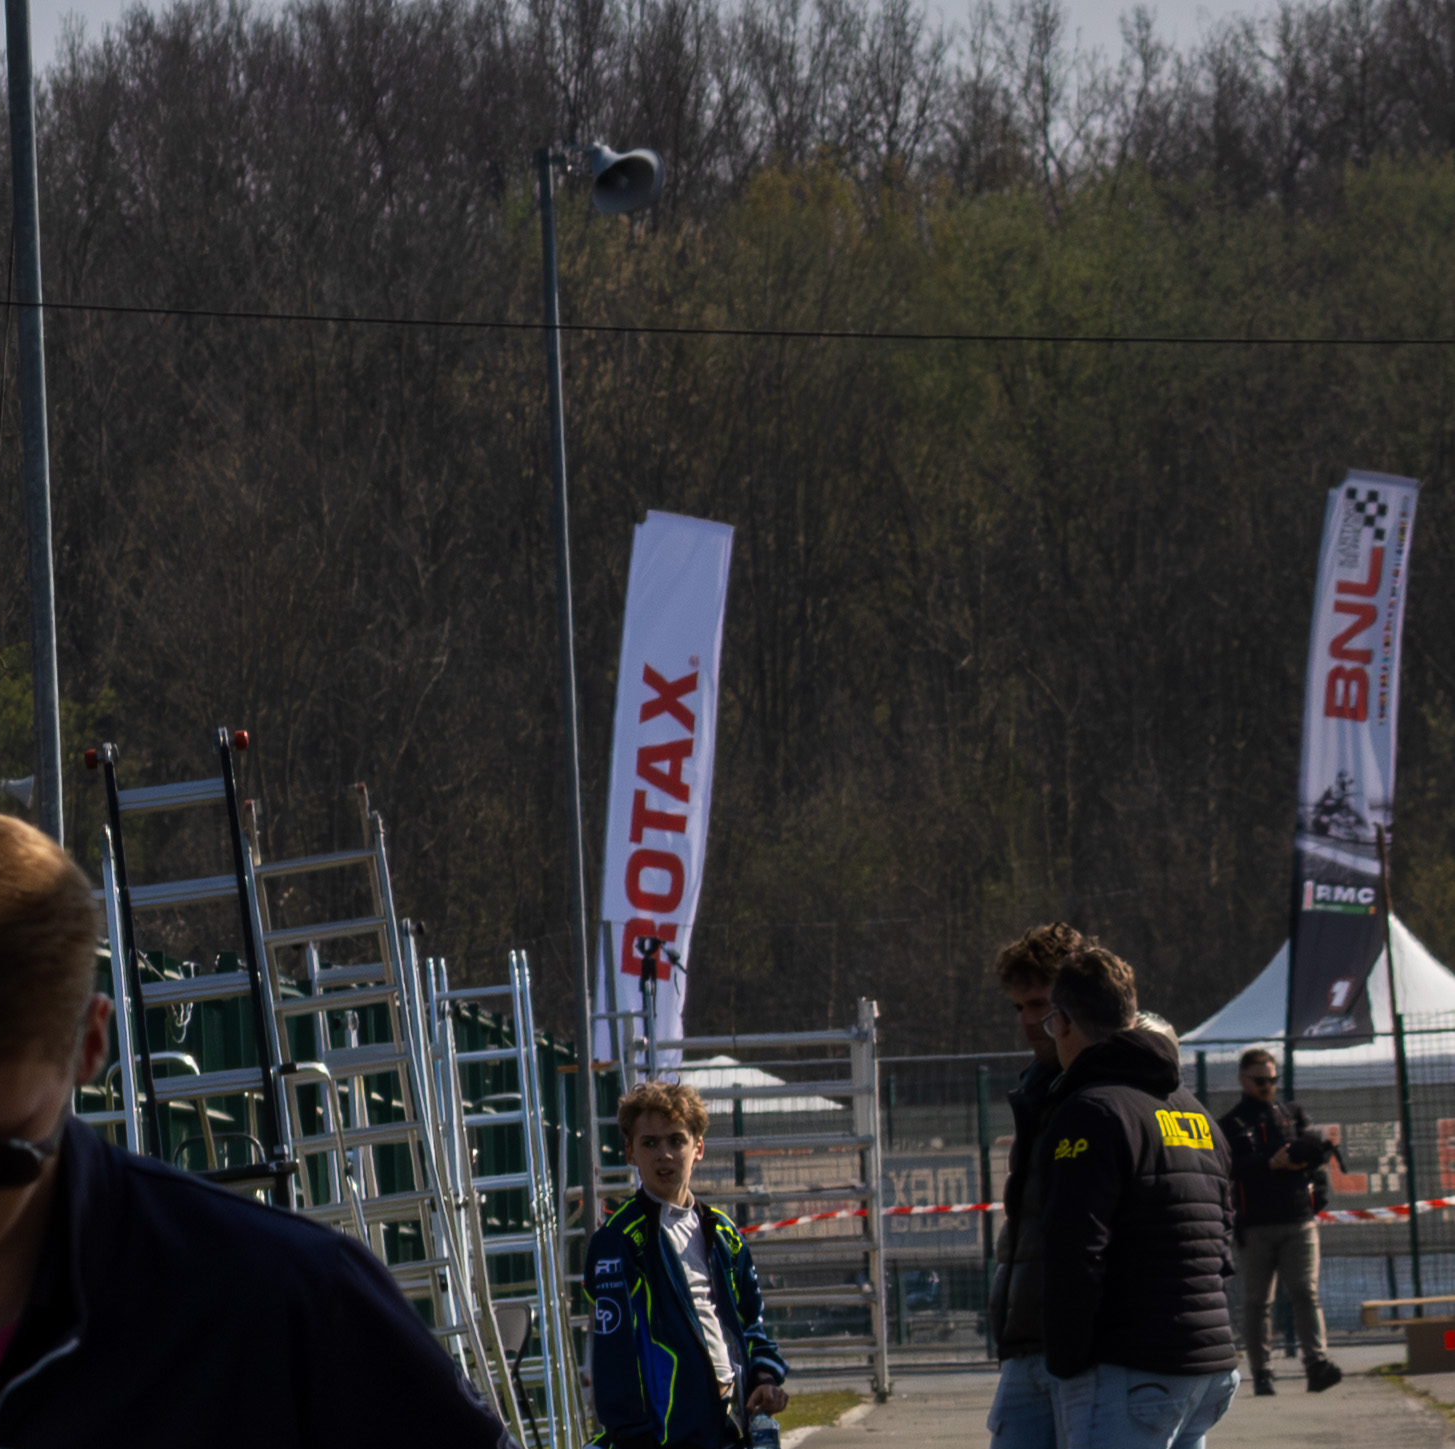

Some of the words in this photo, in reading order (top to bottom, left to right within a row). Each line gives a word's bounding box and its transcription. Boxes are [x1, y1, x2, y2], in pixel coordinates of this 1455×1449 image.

[1324, 546, 1385, 722] BNL
[621, 661, 698, 981] ROTAX
[1315, 884, 1375, 904] RMC
